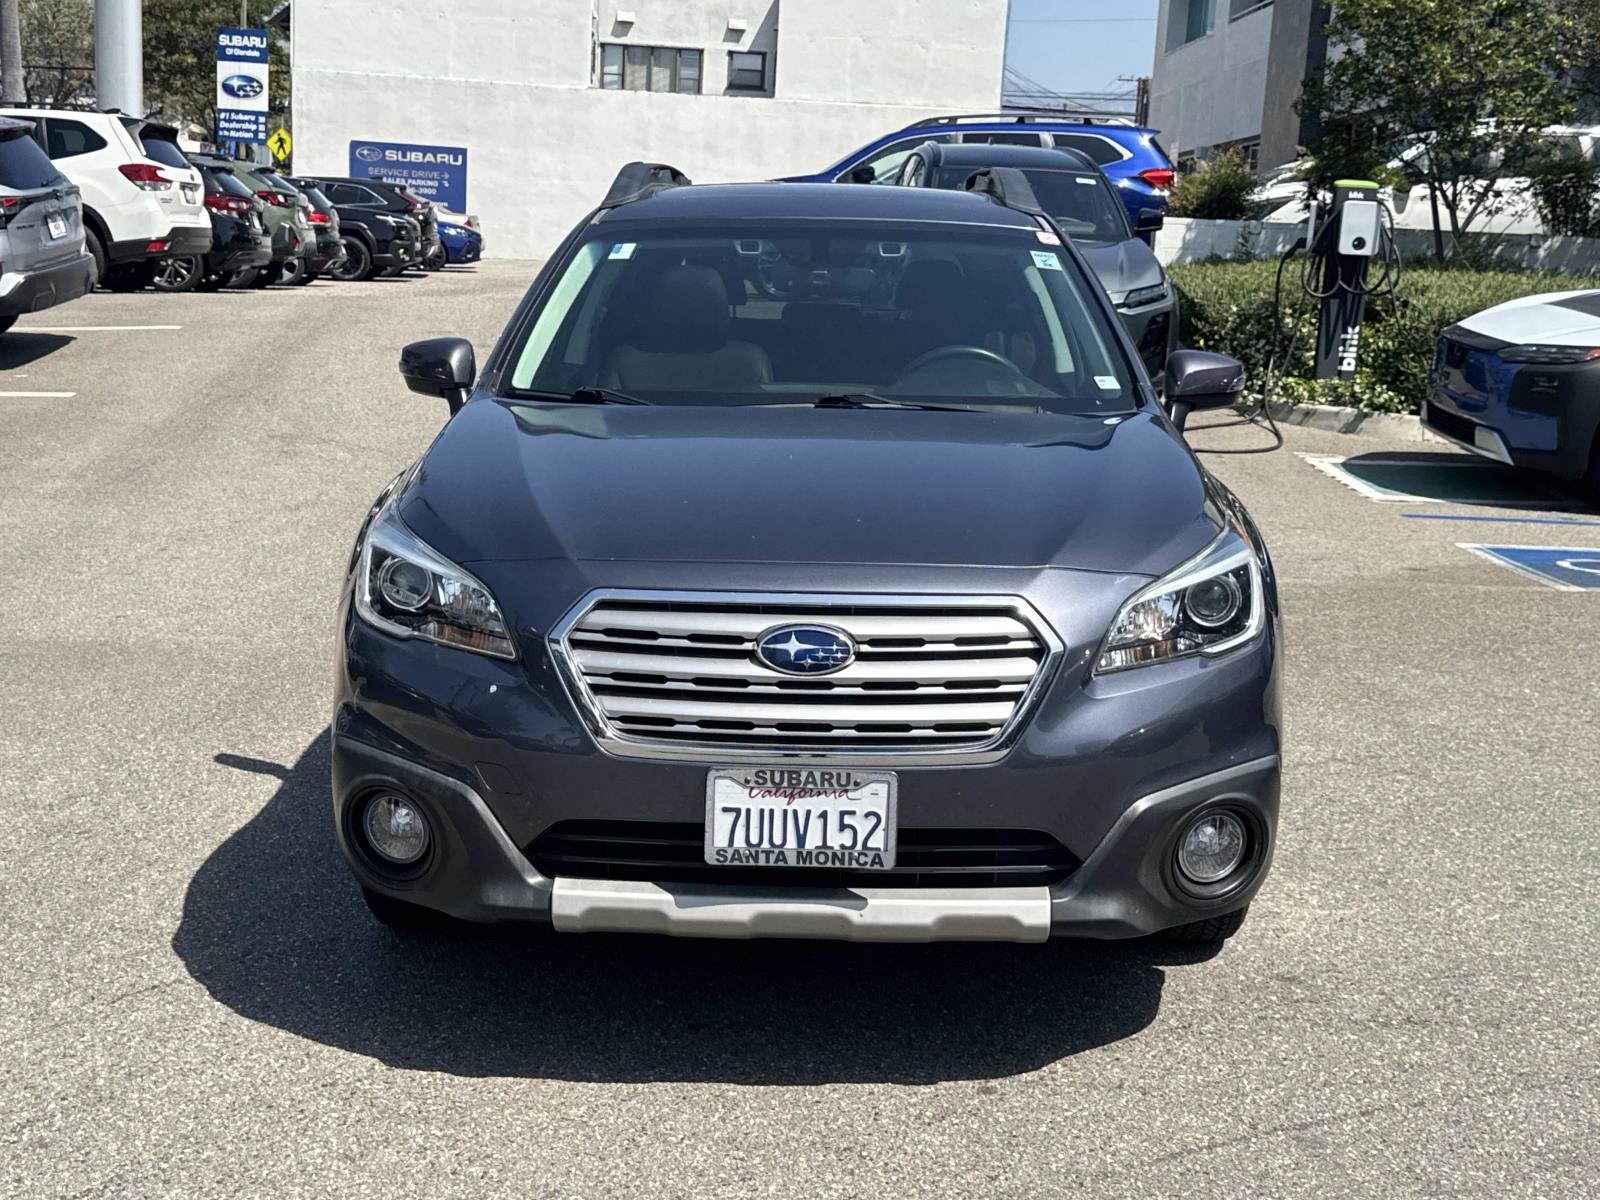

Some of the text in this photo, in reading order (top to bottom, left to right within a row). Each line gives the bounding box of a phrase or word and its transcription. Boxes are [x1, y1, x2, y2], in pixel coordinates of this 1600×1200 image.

[219, 34, 267, 48] SUBARU
[230, 112, 256, 121] Subaru
[220, 121, 257, 131] Dealership
[385, 150, 462, 166] SUBARU
[368, 167, 440, 179] SERVICE DRIVE
[407, 179, 439, 188] PARKING
[1338, 325, 1360, 371] blink
[754, 770, 850, 787] SUBARU
[748, 787, 862, 805] California
[721, 806, 882, 851] 7UUV152
[715, 849, 885, 868] SANTA MONICA
